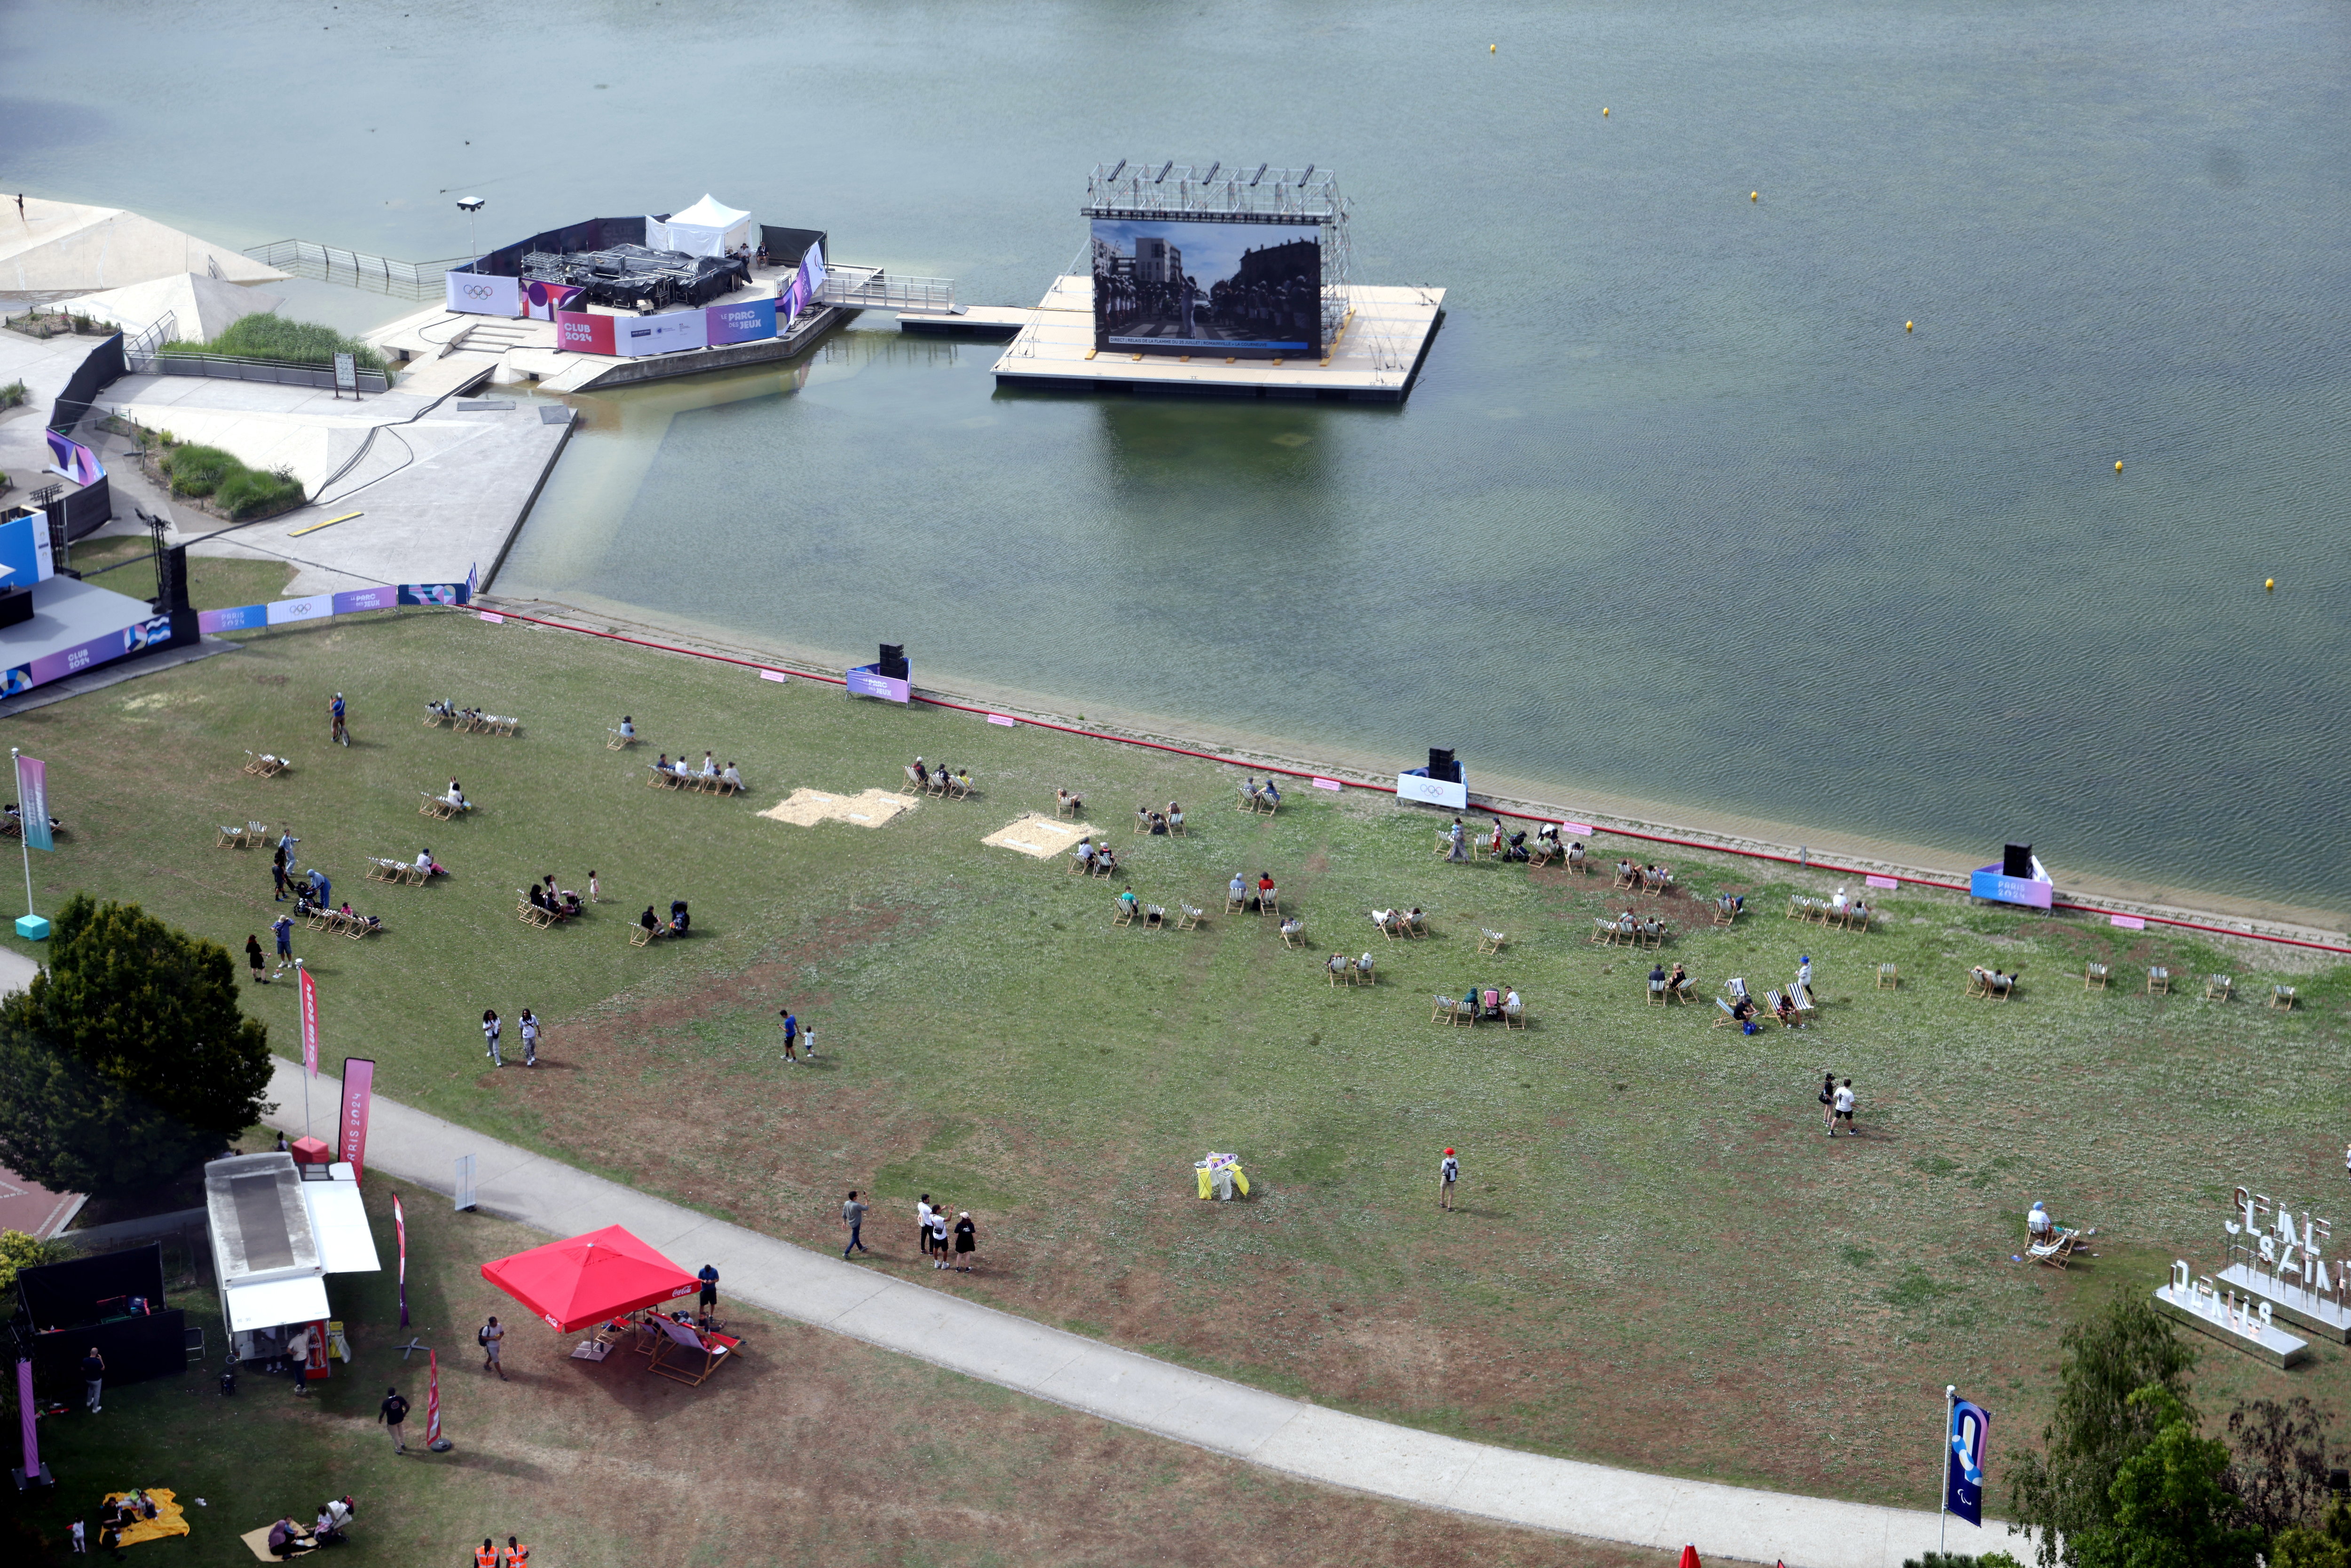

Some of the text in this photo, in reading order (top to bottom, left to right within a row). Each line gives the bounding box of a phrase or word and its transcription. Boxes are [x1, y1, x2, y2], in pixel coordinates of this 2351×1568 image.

[728, 310, 755, 321] PARC
[564, 323, 591, 332] CLUB
[740, 319, 761, 329] JEUX
[565, 332, 592, 342] 2024
[356, 593, 376, 602] PARC
[222, 619, 245, 628] 2024
[68, 649, 88, 662] CLUB
[69, 657, 89, 670] 2024
[868, 679, 887, 688] PARC
[876, 687, 891, 696] JEUX
[27, 800, 37, 827] JEUX
[1998, 888, 2025, 899] 2024
[351, 1093, 361, 1126] 2024
[672, 1285, 692, 1297] Coca-Cola
[545, 1314, 559, 1328] Coca-Cola
